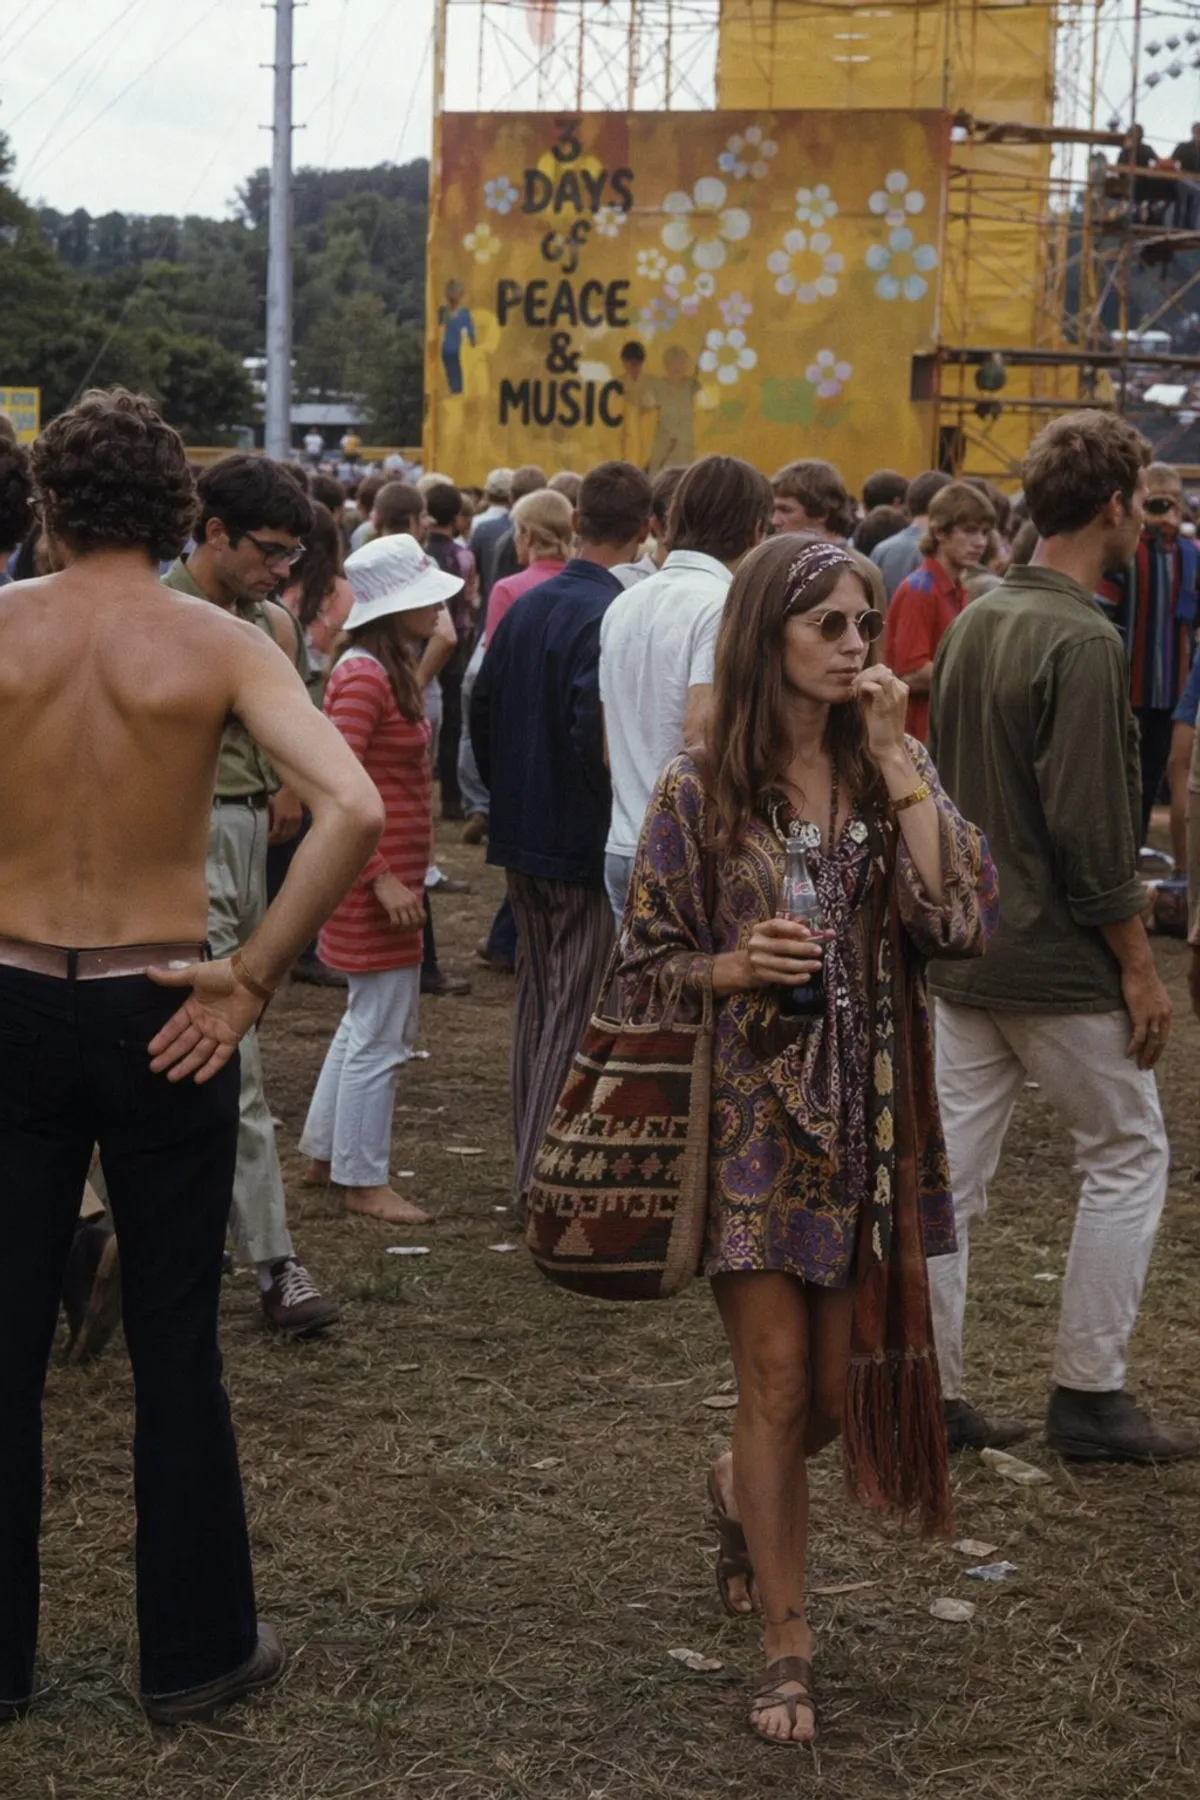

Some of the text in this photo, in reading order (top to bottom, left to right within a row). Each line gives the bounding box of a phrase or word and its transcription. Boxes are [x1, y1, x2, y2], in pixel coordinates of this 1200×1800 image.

[552, 119, 582, 163] 3
[520, 168, 634, 214] DAYS
[496, 279, 631, 328] PEACE
[545, 332, 581, 374] &
[499, 378, 625, 428] MUSIC
